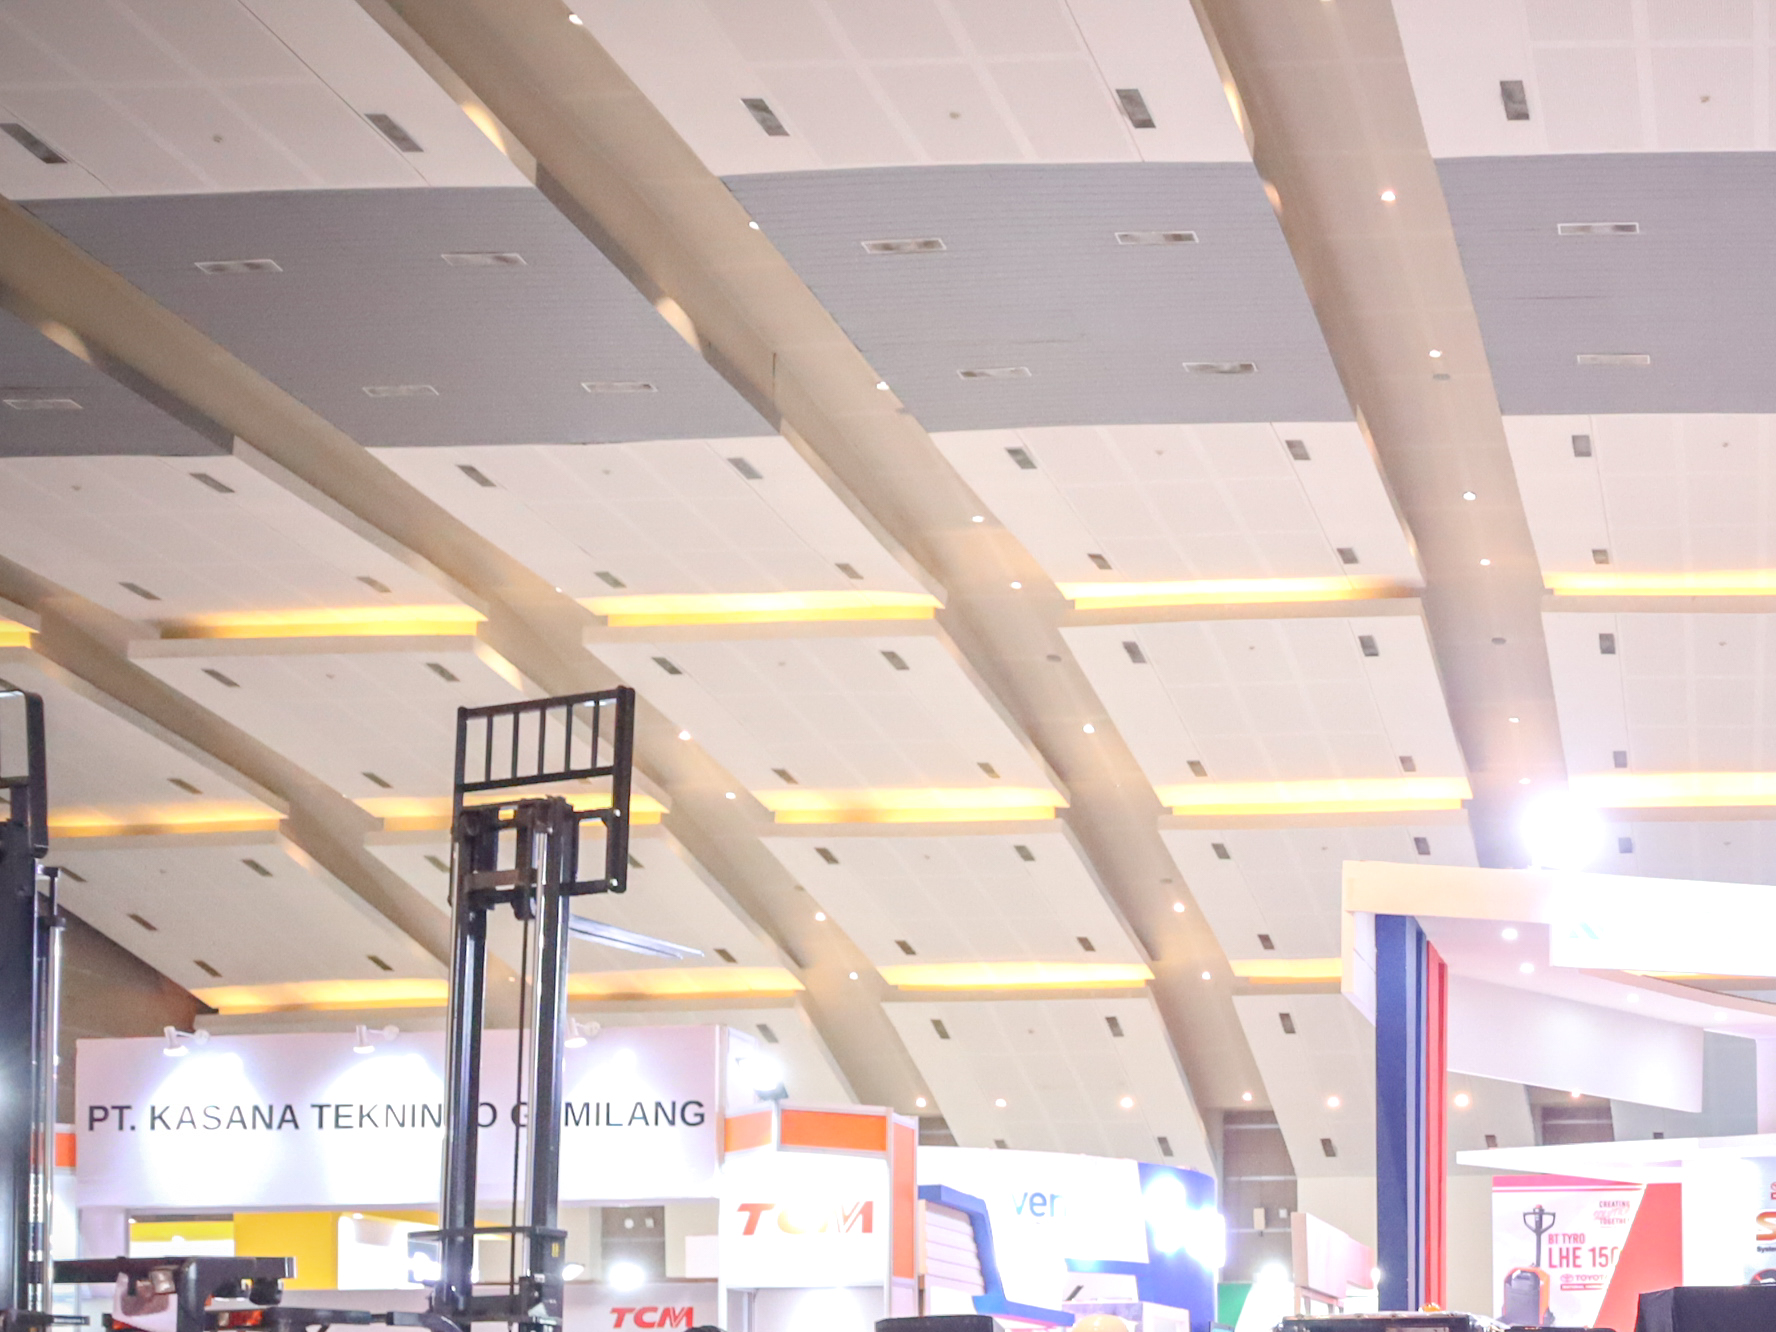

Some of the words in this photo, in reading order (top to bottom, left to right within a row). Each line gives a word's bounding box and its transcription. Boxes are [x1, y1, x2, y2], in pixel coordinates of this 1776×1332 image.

[88, 1105, 136, 1131] PT.
[150, 1104, 300, 1131] KASANA
[311, 1102, 498, 1129] TEKNINO
[510, 1100, 706, 1128] GMILANG
[1548, 1234, 1559, 1245] BT
[1563, 1233, 1585, 1245] TYRO
[1548, 1247, 1582, 1269] LHE
[610, 1306, 695, 1329] TCM
